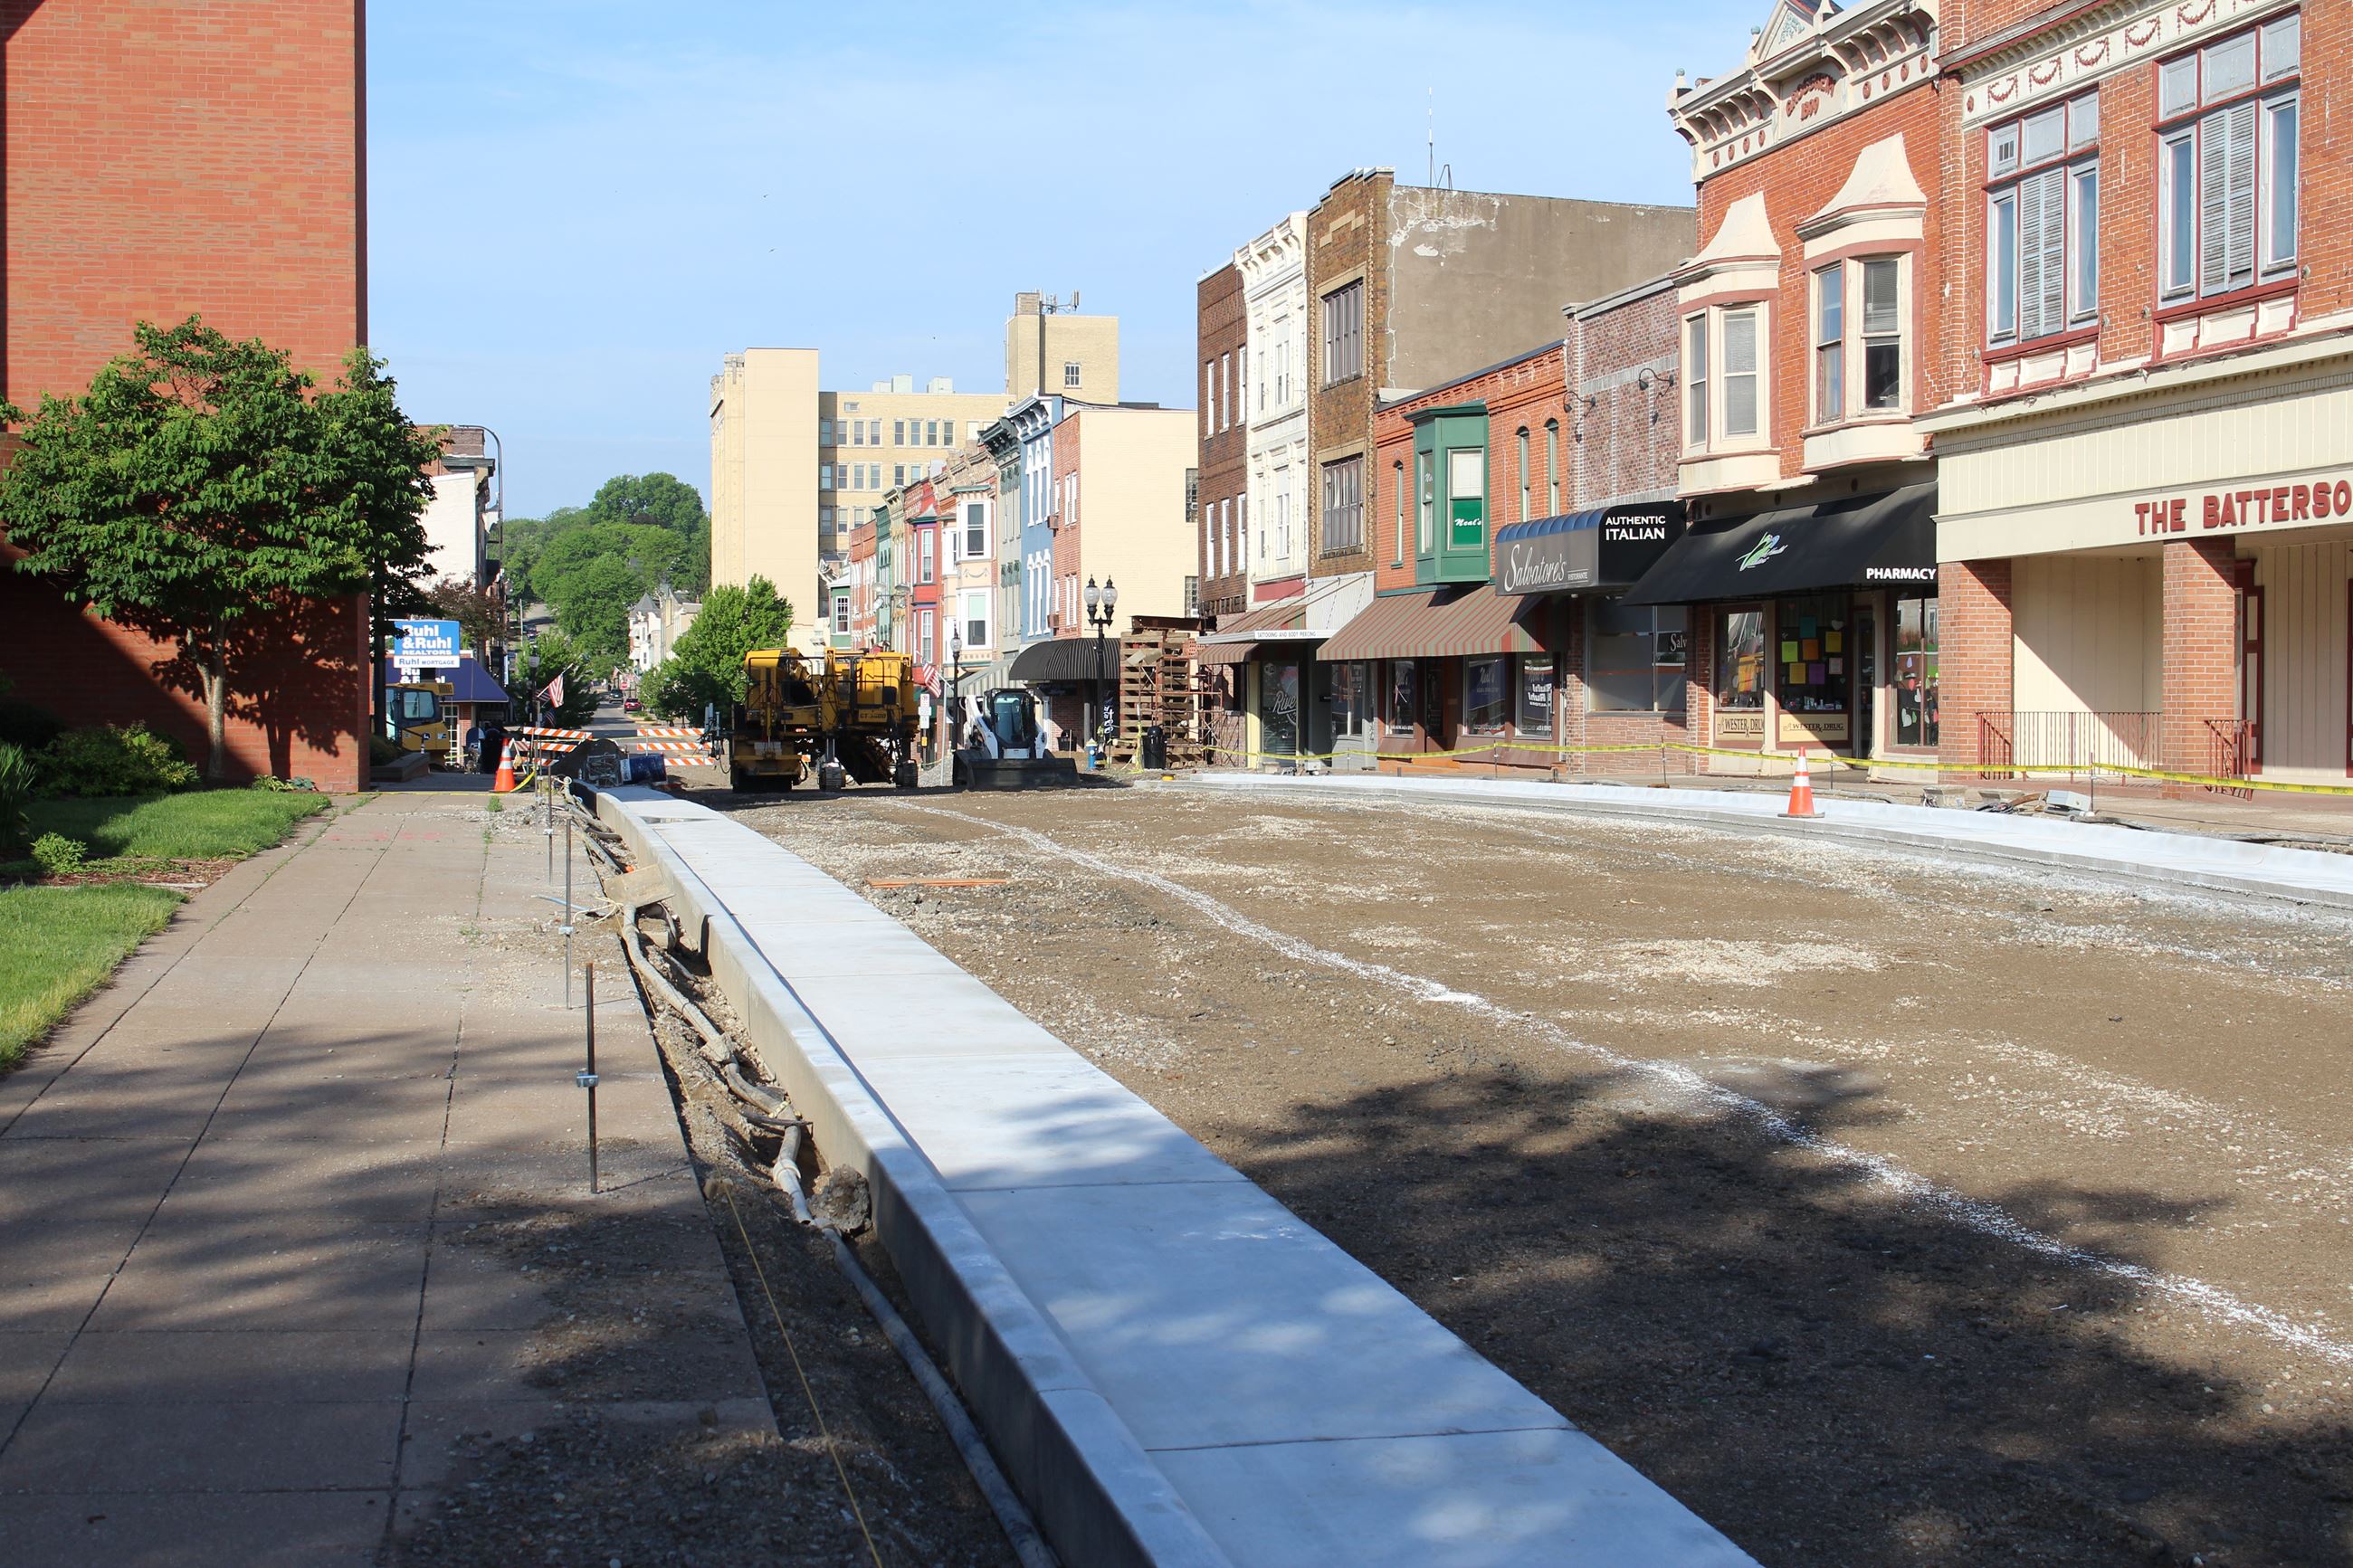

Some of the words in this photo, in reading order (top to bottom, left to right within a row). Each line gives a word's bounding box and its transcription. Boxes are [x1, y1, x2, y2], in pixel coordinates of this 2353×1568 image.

[2134, 499, 2186, 536] THE
[2203, 480, 2353, 529] BATTERSO
[1454, 518, 1481, 527] Neal's
[1605, 516, 1666, 526] AUTHENTIC
[1605, 527, 1665, 541] ITALIAN
[1504, 543, 1567, 593] Salvatore's
[1567, 571, 1588, 581] RISTORANTE
[1866, 567, 1937, 580] PHARMACY
[402, 625, 439, 636] Ruhl
